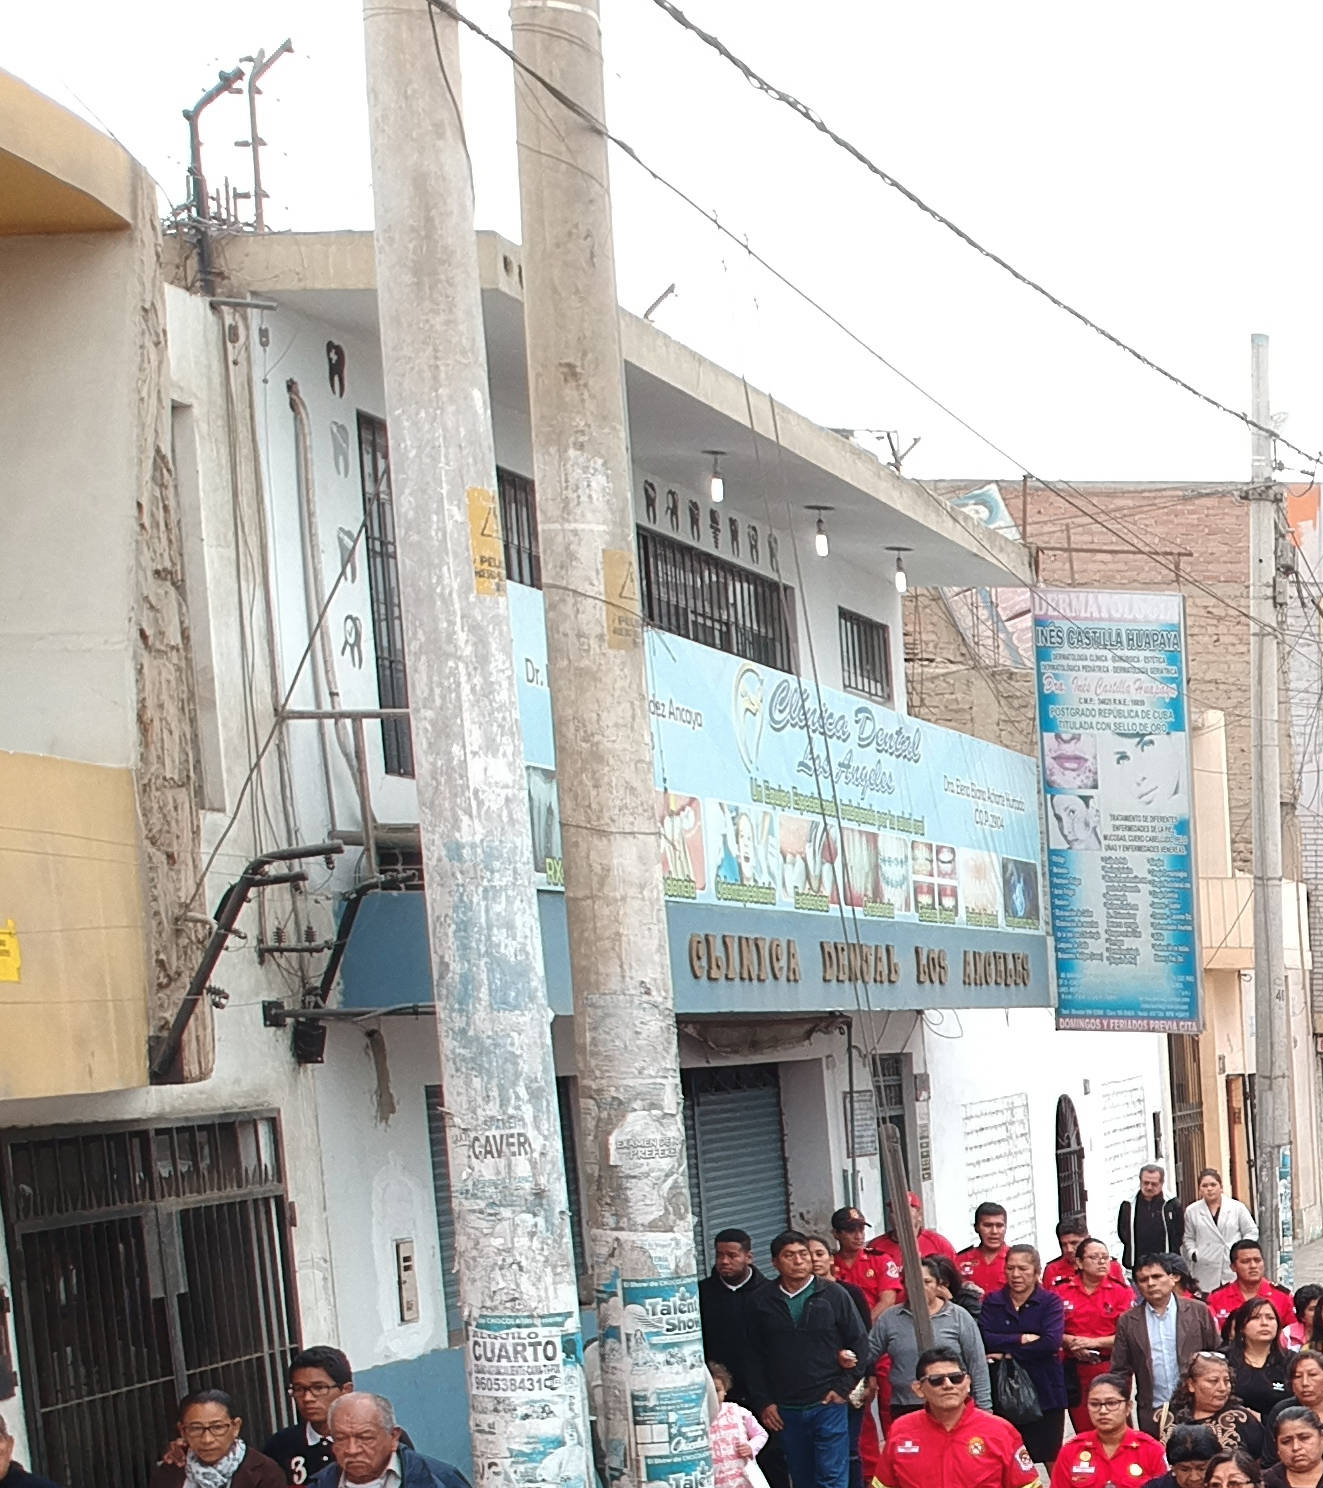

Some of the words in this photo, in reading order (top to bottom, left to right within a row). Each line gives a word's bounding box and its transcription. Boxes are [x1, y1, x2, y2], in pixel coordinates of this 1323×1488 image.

[1036, 621, 1064, 647] INÉS
[1068, 628, 1123, 649] CASTILLA
[1127, 629, 1181, 650] HUAPAYA
[524, 657, 544, 687] Dr.
[1050, 707, 1097, 718] POSTGRADO
[1141, 710, 1151, 719] DE
[1152, 711, 1174, 721] CUBA
[855, 706, 923, 763] Dental
[1058, 720, 1095, 731] TITULADA
[1096, 721, 1112, 732] CON
[1113, 722, 1138, 732] SELLO
[1139, 723, 1149, 732] DE
[1151, 723, 1168, 733] ORO
[689, 932, 801, 983] CLINICA
[820, 941, 900, 984] DENTAL
[914, 945, 949, 985] LOS
[963, 950, 1031, 986] ANGELES
[1059, 1018, 1101, 1030] DOMINGOS
[1103, 1018, 1108, 1030] Y
[1110, 1020, 1148, 1031] FERIADOS
[1150, 1021, 1177, 1031] PREVIA
[1179, 1021, 1198, 1032] CITA
[472, 1340, 557, 1363] CUARTO
[474, 1376, 544, 1393] 960538431
